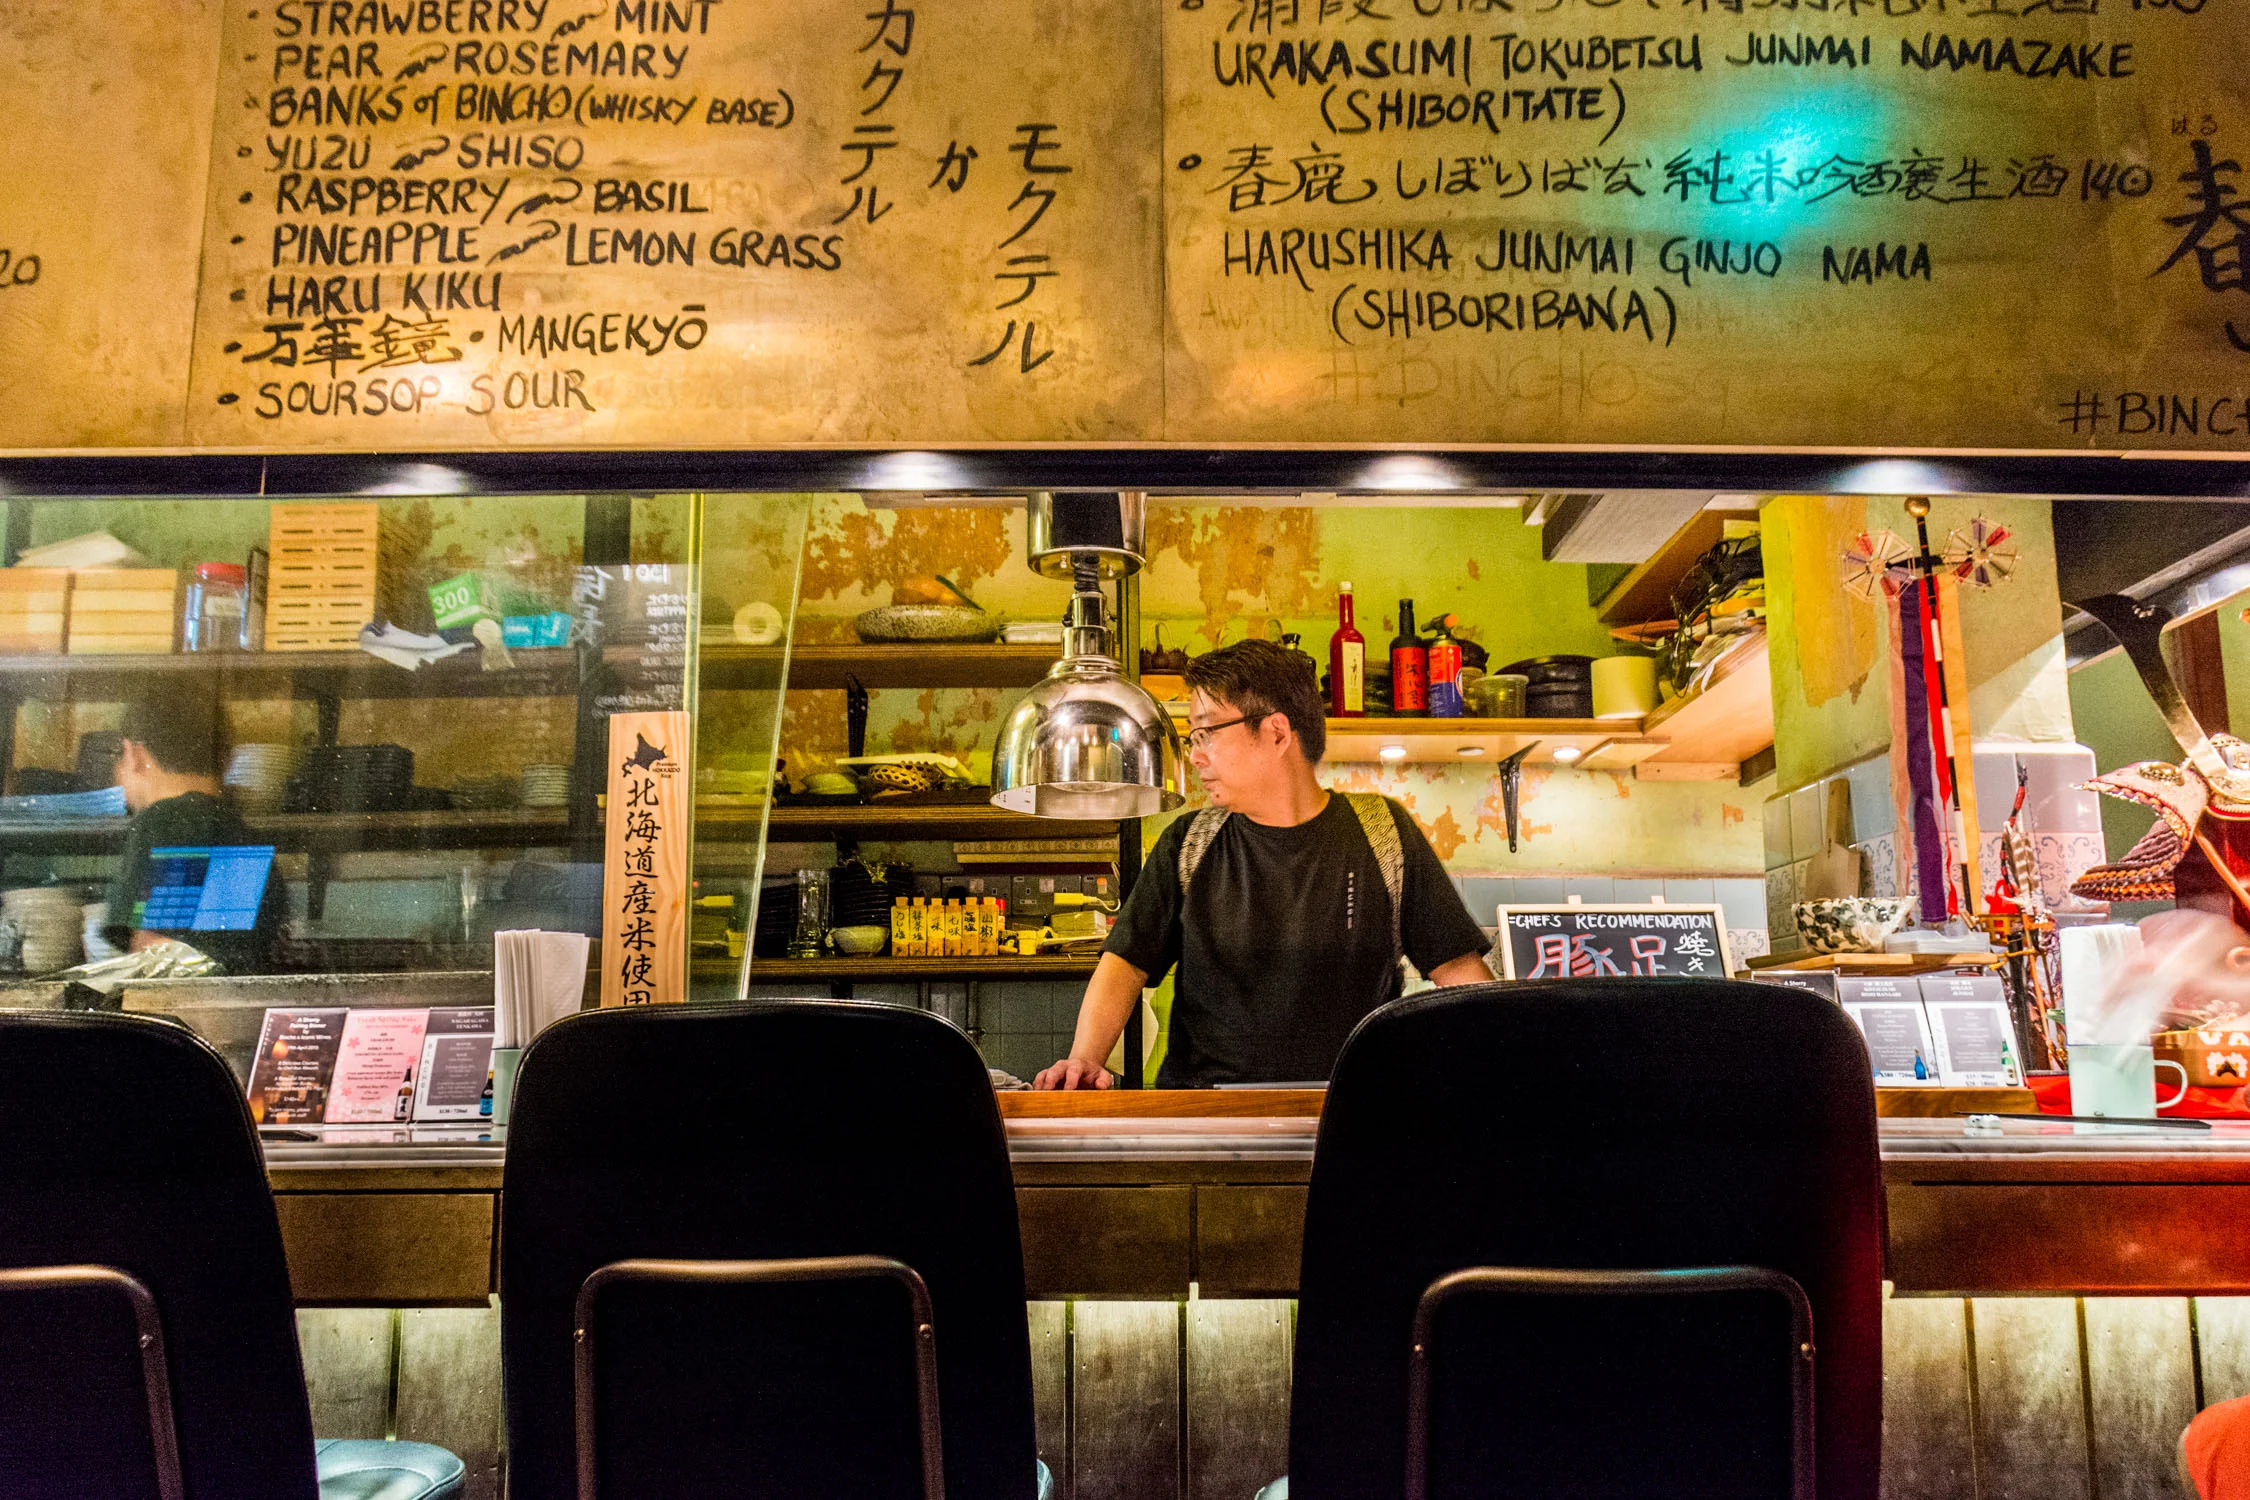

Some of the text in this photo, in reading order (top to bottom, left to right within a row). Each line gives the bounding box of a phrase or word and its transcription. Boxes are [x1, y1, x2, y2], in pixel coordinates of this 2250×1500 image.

[274, 0, 547, 37] STRAWBERRY
[615, 0, 723, 34] MINT
[273, 41, 382, 82] PEAR
[454, 41, 689, 79] ROSEMARY
[1212, 32, 2135, 98] URAKASUMI TOKUBETSU JUNMAI NAMAZAKE
[269, 84, 407, 127] BANKS
[414, 84, 447, 126] of
[706, 88, 794, 129] BASE)
[832, 0, 915, 225] カクテル
[1320, 78, 1626, 146] (SHIBORITATE)
[264, 134, 371, 172] YUZU
[456, 132, 585, 171] SHISO
[929, 139, 978, 193] か
[276, 172, 510, 225] RASPBERRY
[593, 178, 710, 214] BASIL
[272, 220, 480, 268] PINEAPPLE
[566, 222, 697, 269] LEMON
[710, 227, 846, 272] GRASS
[967, 123, 1073, 374] モクテル
[1224, 227, 1932, 292] HARUSHIKA JUNMAI GINJO NAMA
[265, 271, 502, 317] HARU KIKU
[1331, 283, 1678, 348] (SHIBORIBANA)
[254, 368, 597, 420] SOURSOP SOUR
[433, 586, 470, 615] 300
[1575, 913, 1713, 930] RECOMMENDATION
